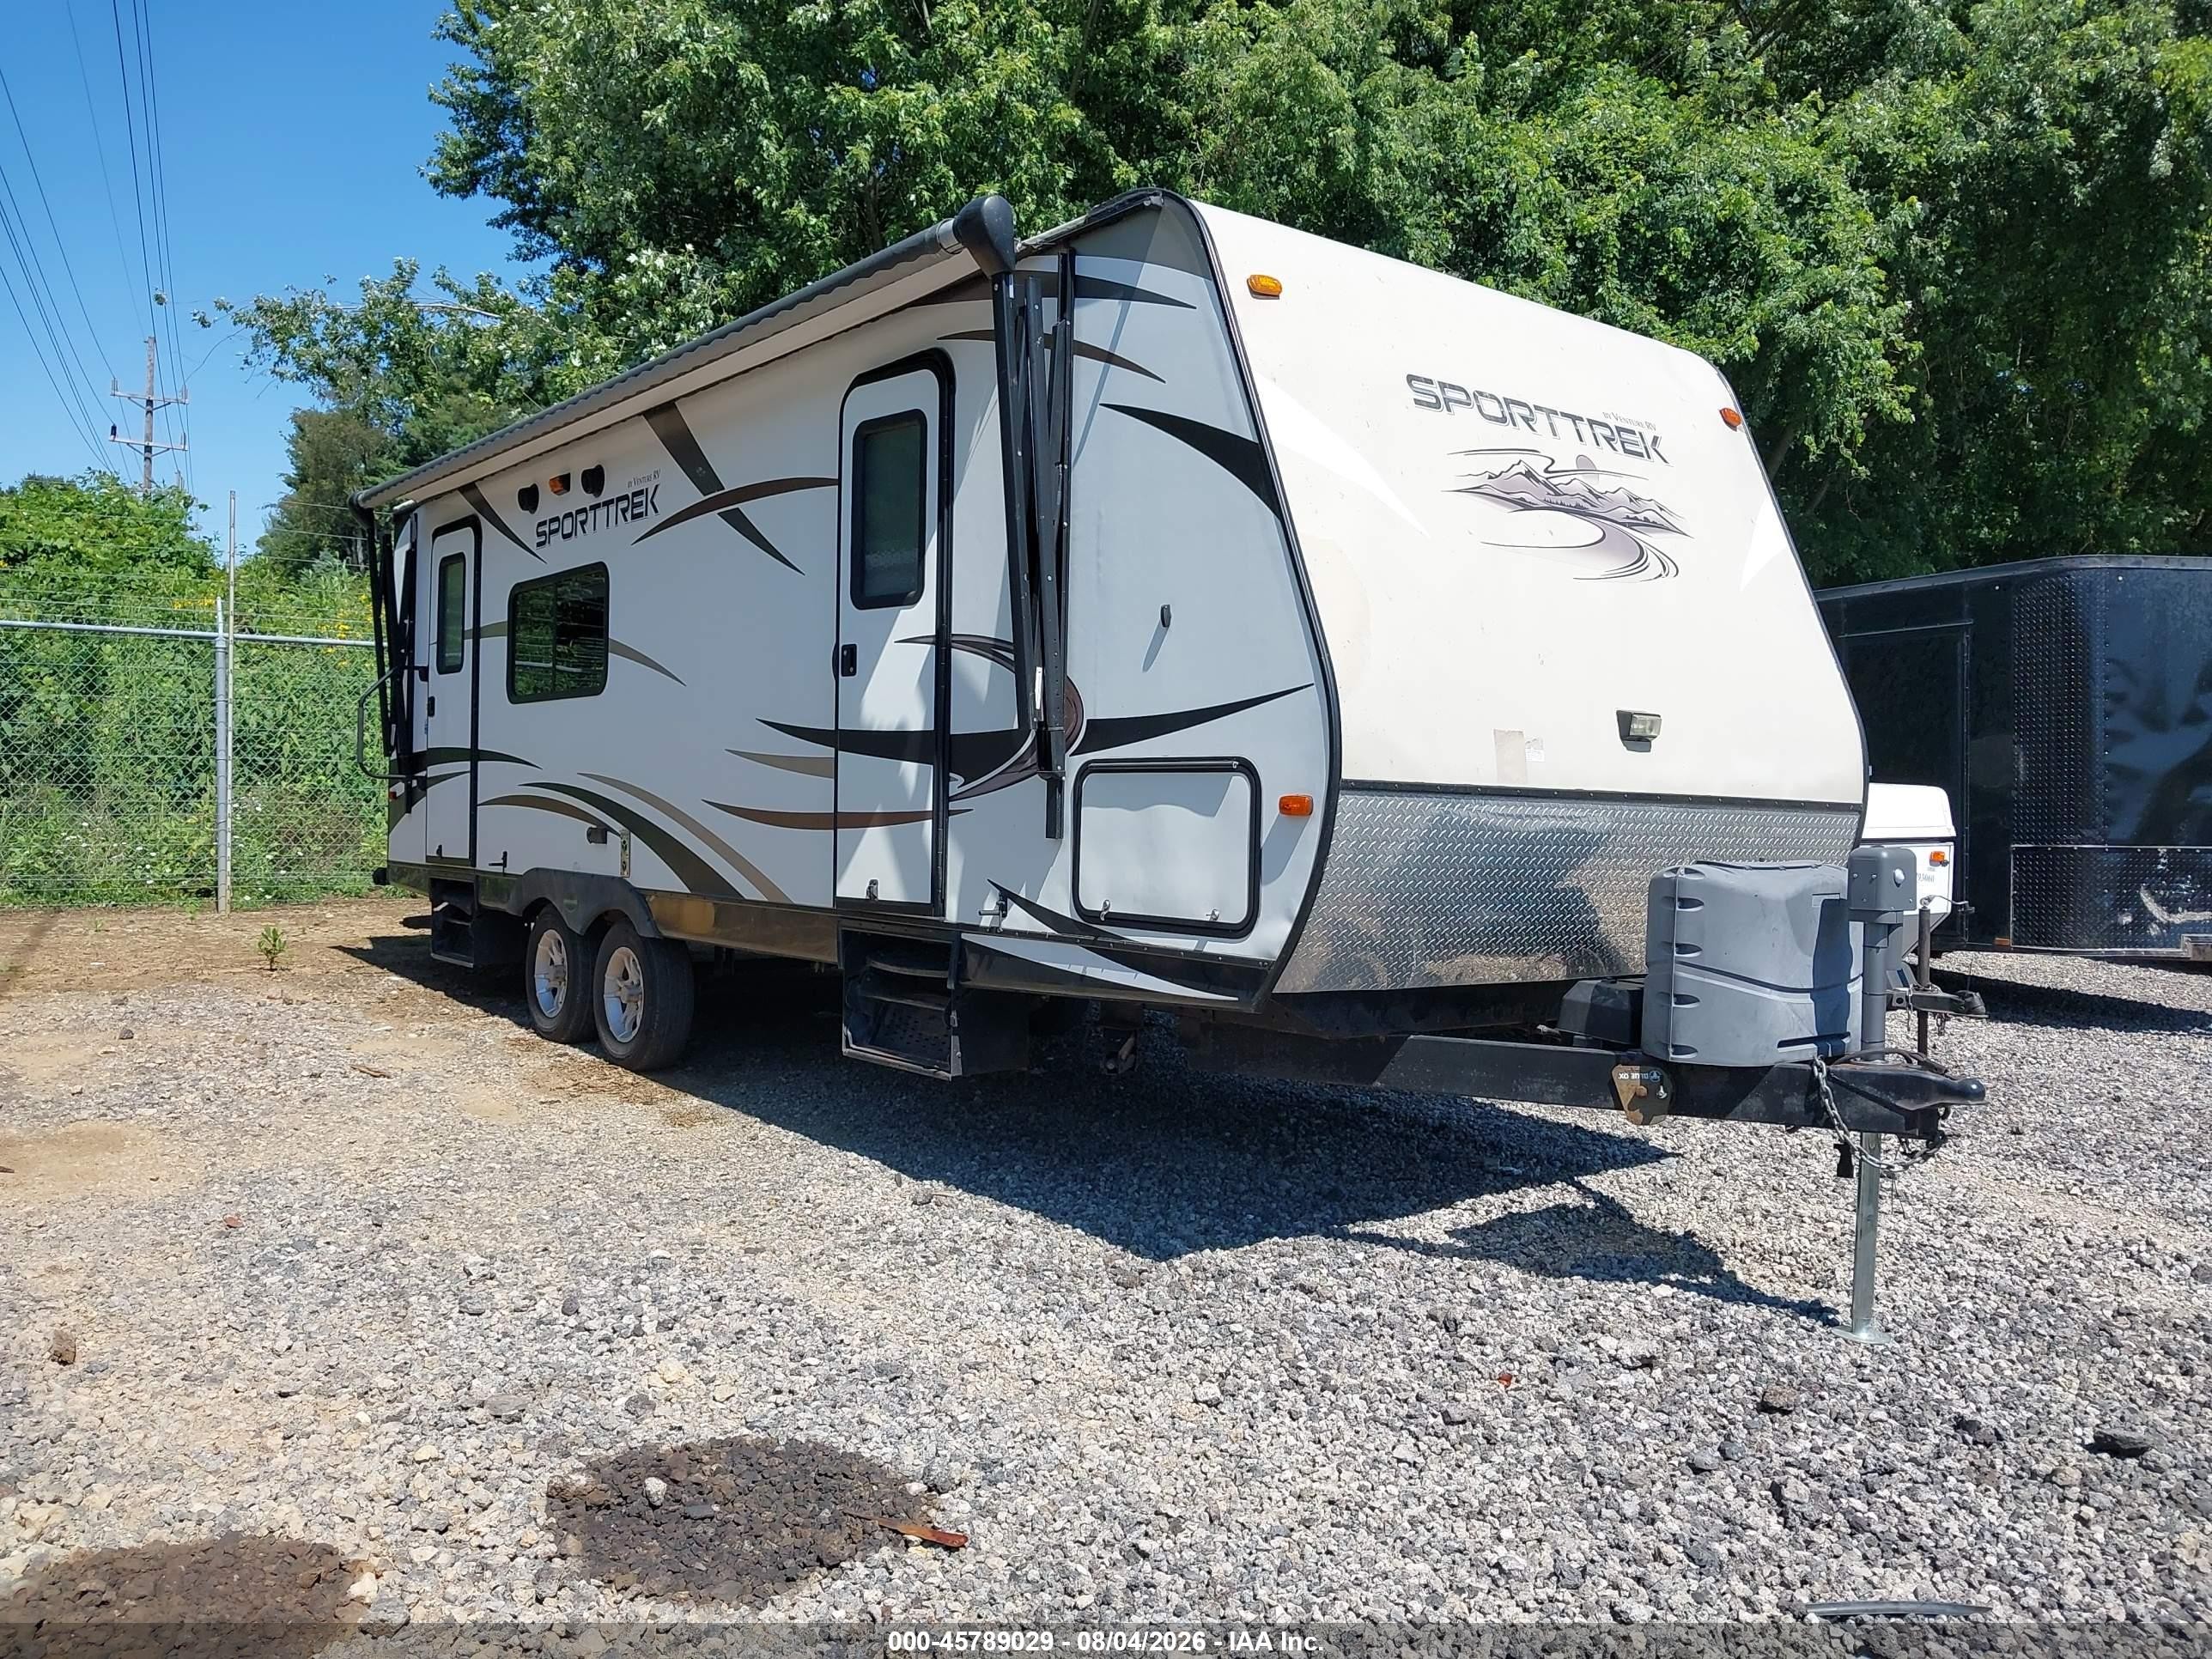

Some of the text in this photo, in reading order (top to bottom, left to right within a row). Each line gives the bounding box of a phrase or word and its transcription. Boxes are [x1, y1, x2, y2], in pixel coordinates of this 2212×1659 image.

[1406, 374, 1671, 465] SPORTTREK
[1645, 421, 1656, 431] RV
[653, 469, 660, 480] RV
[535, 483, 660, 549] SPORTTREK
